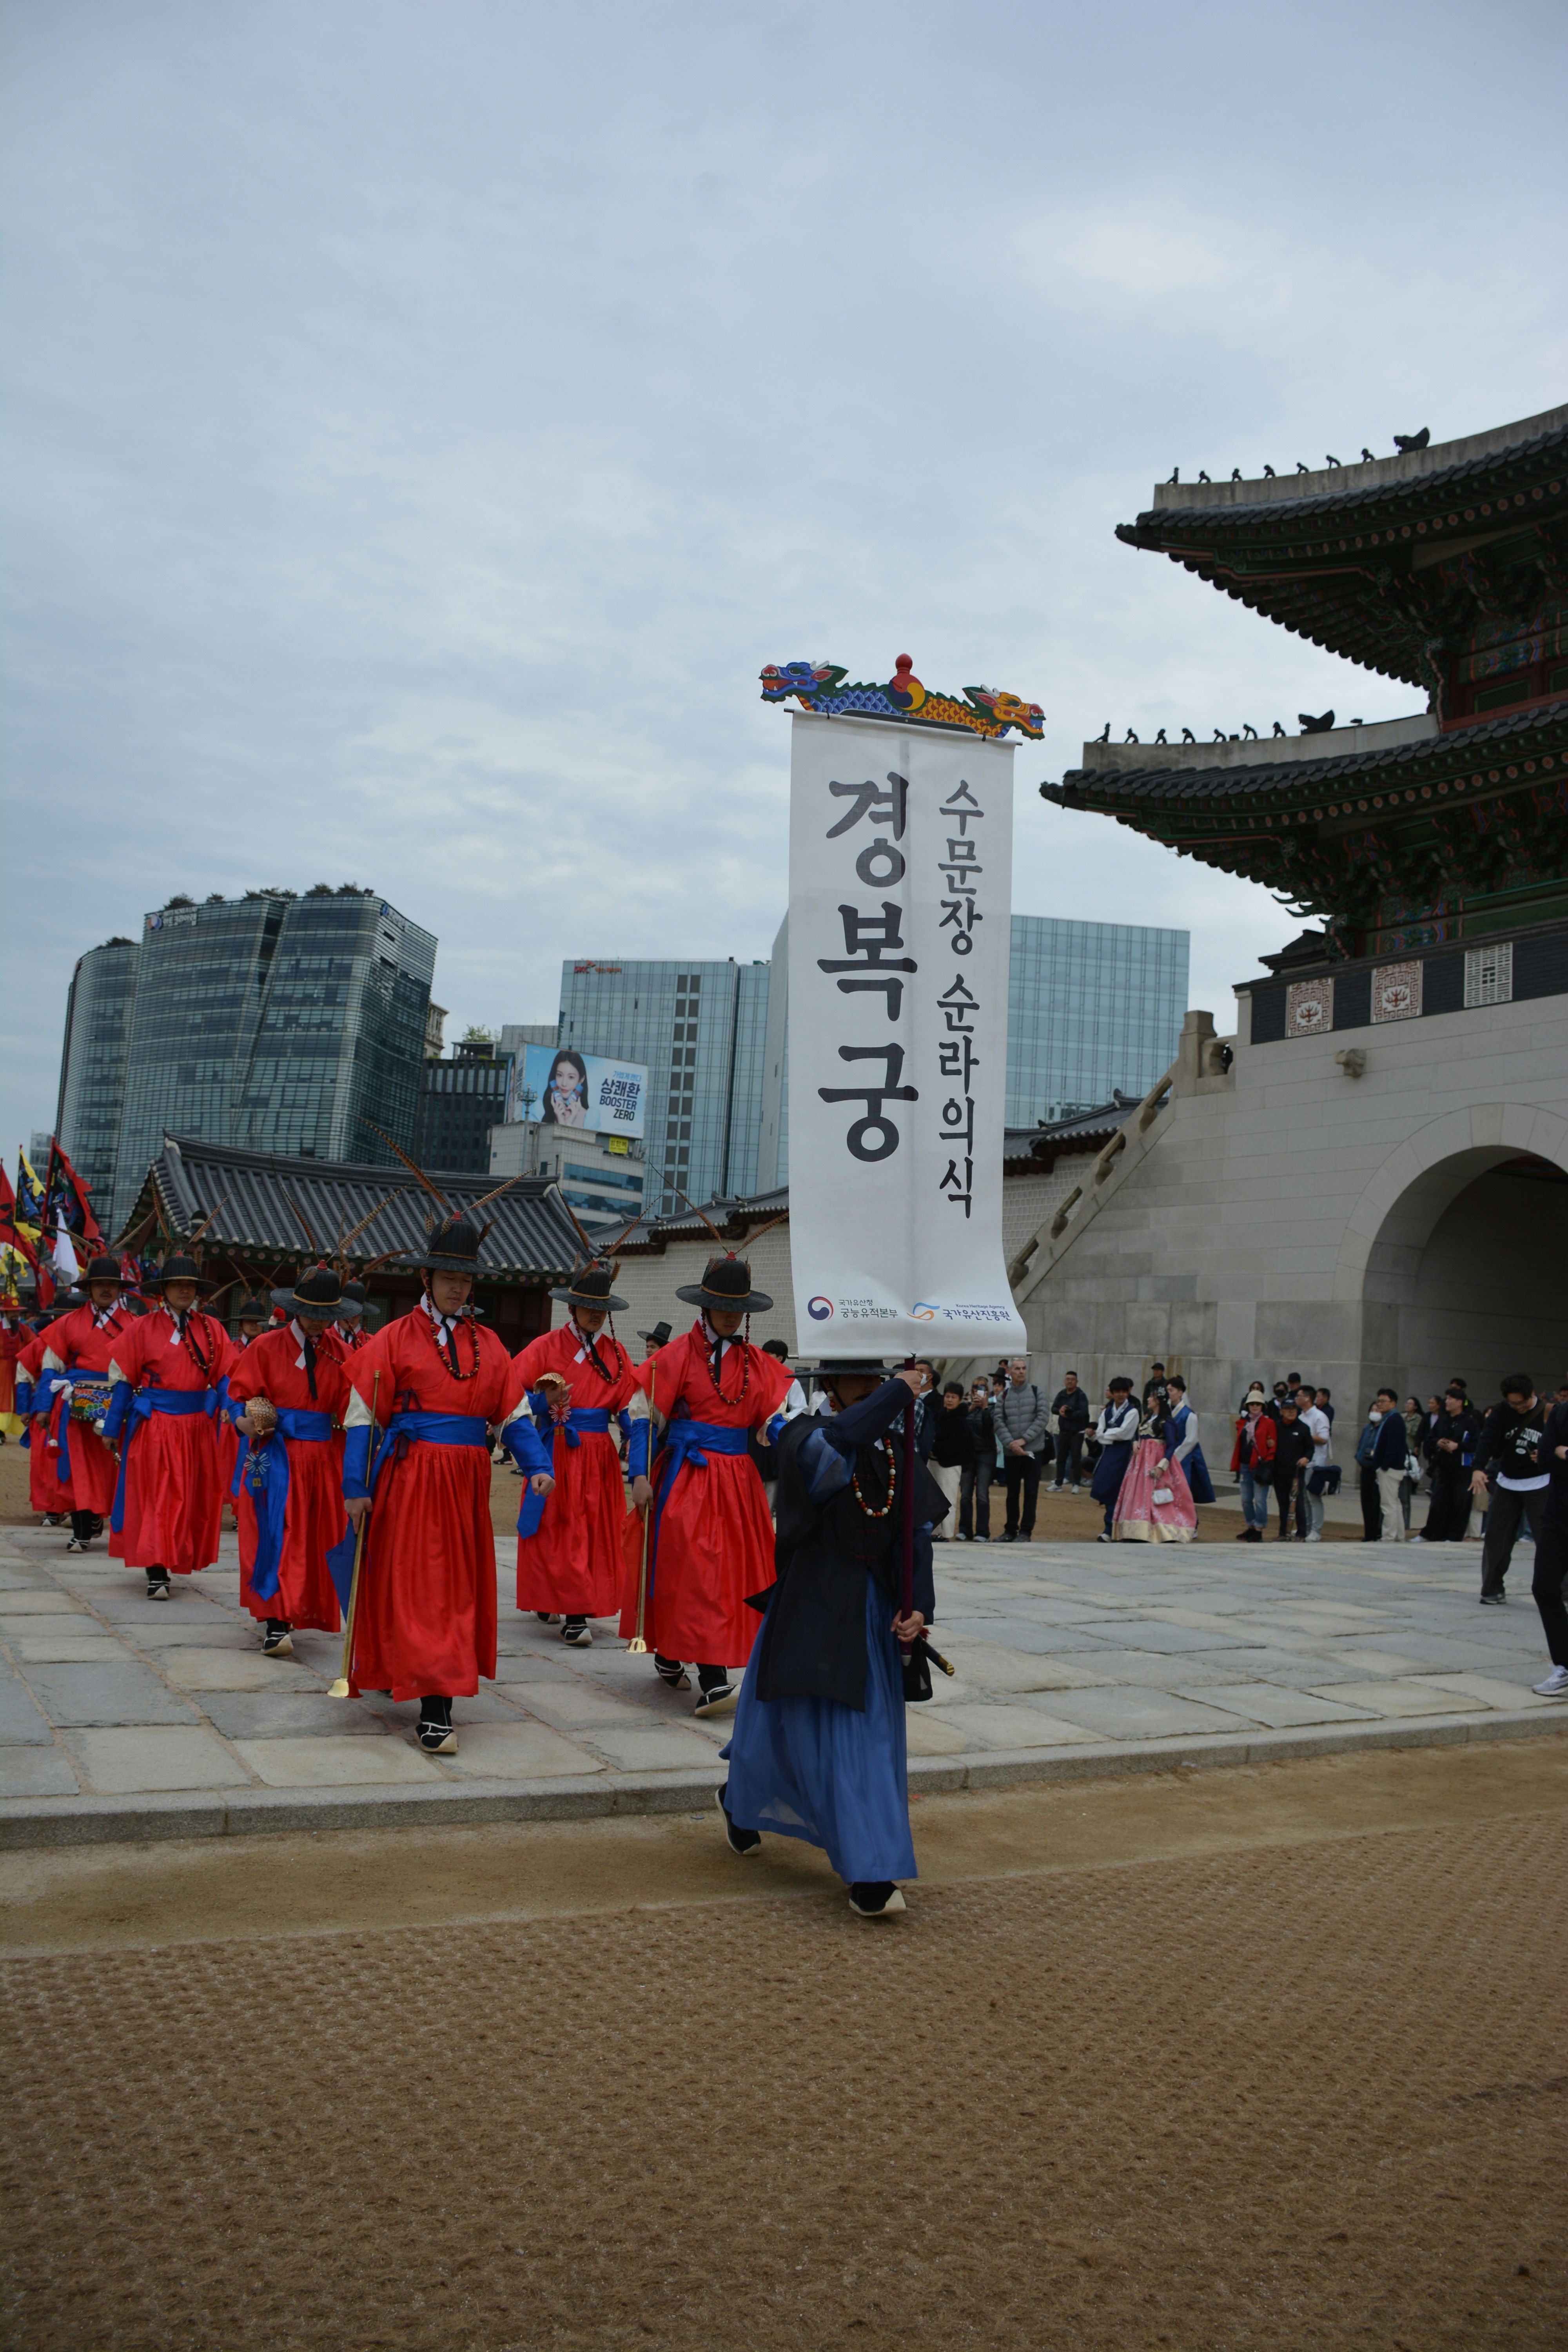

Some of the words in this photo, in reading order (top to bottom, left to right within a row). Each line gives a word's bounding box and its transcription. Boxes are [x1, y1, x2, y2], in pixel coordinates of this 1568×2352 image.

[938, 780, 984, 955] 수문장
[817, 771, 919, 1162] 경복궁
[601, 1078, 640, 1099] 상쾌환
[936, 973, 980, 1219] 순라의식
[600, 1095, 637, 1111] BOOSTER
[613, 1109, 635, 1121] ZERO
[840, 1308, 898, 1318] 궁능유적본부
[942, 1309, 1012, 1321] 국가유산진흥원
